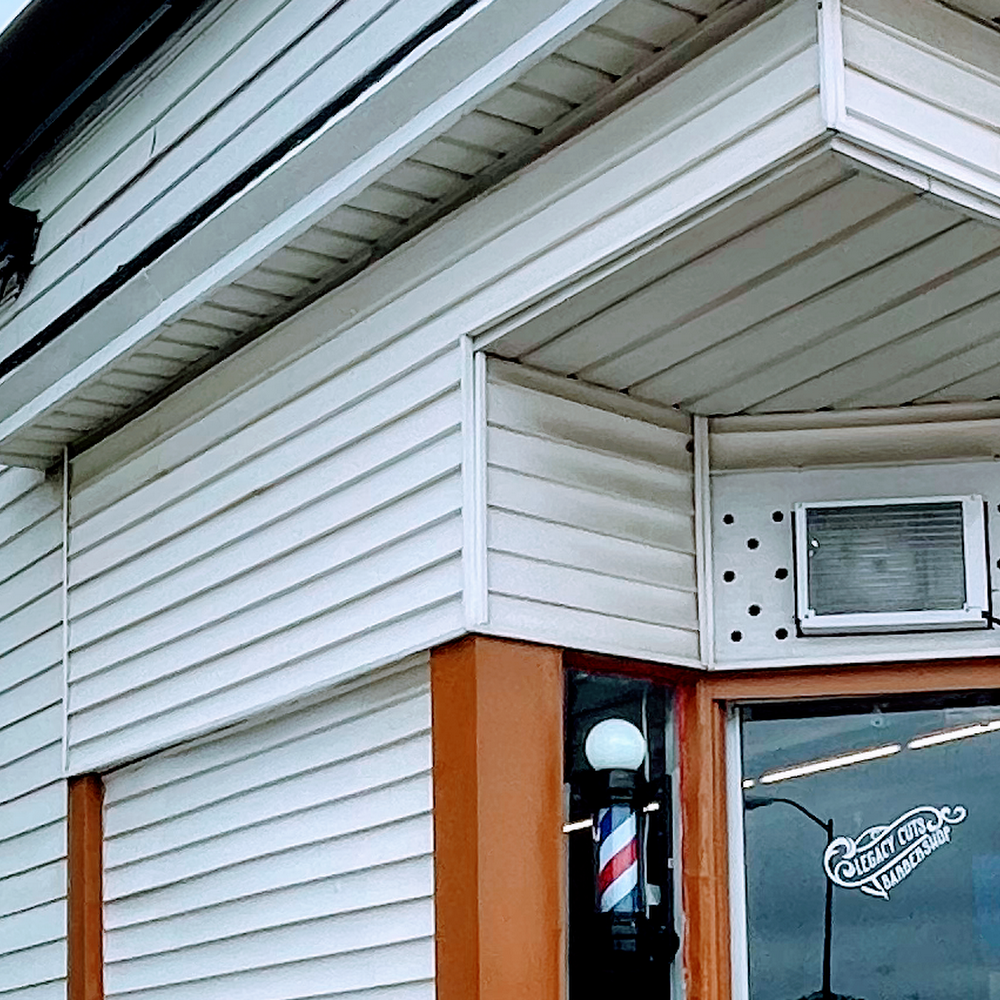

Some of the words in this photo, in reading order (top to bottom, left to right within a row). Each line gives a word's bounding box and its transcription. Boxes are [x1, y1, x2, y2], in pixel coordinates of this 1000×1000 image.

[853, 838, 896, 875] LEGACY
[897, 817, 927, 847] CUTS
[881, 825, 952, 890] BARBERSHOP
